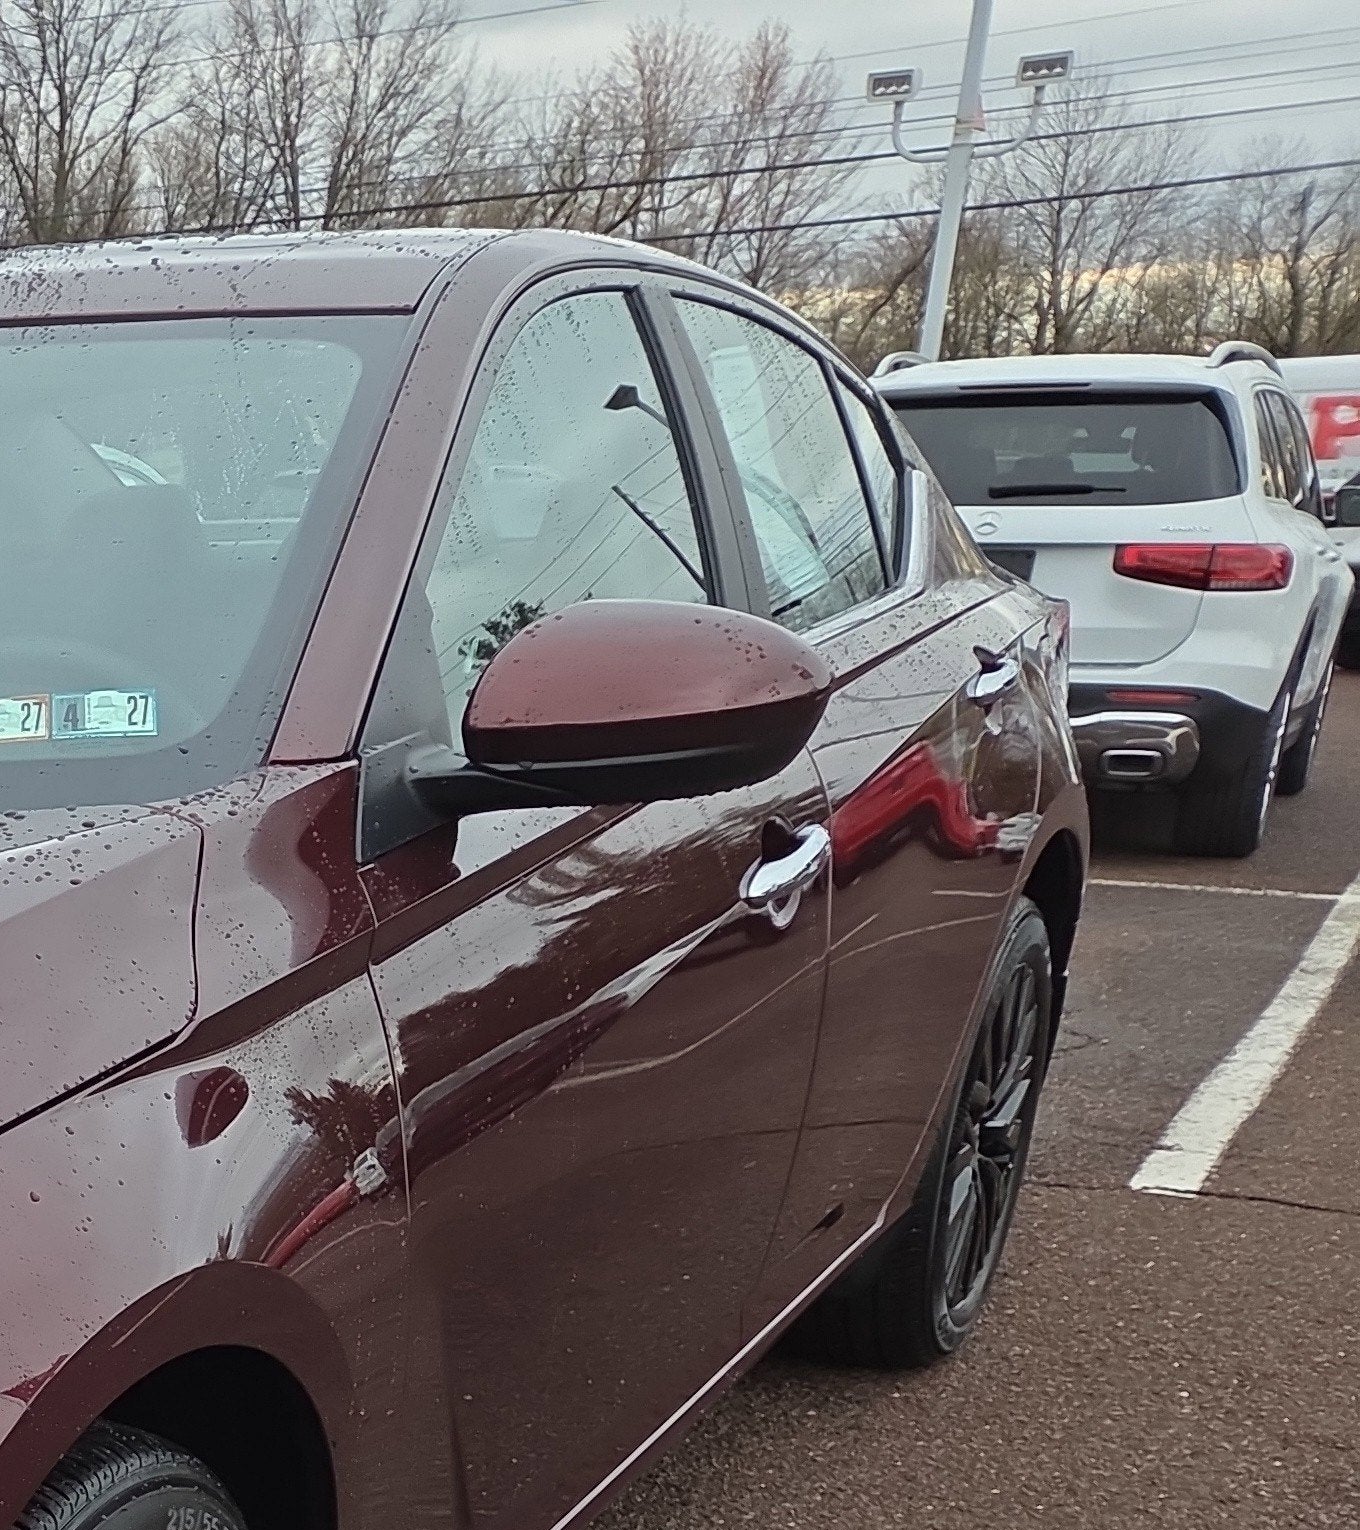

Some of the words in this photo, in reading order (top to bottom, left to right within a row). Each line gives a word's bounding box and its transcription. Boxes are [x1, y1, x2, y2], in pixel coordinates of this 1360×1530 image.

[20, 701, 44, 734] 27
[61, 703, 80, 732] 4
[126, 694, 150, 727] 27
